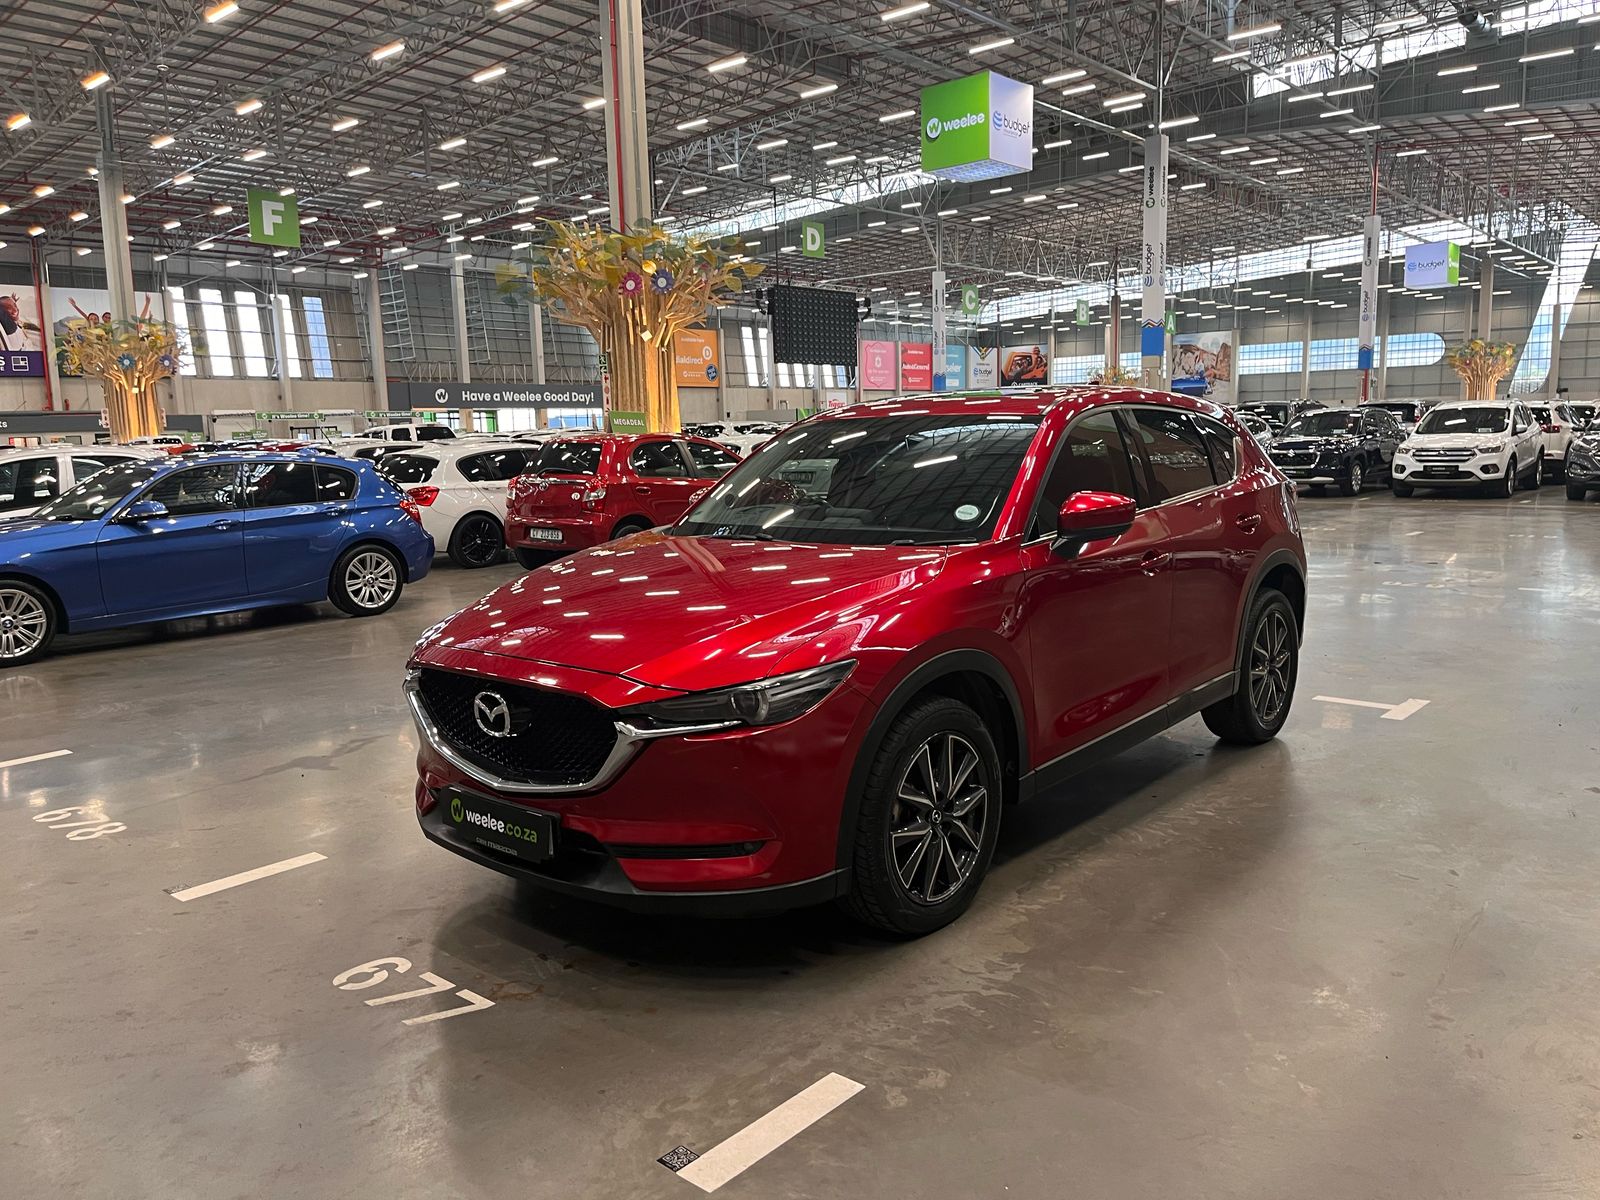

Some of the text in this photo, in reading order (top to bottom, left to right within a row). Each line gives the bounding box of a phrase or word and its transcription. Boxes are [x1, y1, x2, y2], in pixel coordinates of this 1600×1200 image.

[943, 112, 985, 132] weelee
[1003, 114, 1030, 137] budget
[261, 200, 285, 237] F
[806, 226, 821, 253] D
[1144, 243, 1155, 275] budget
[1417, 259, 1445, 269] budget
[965, 290, 976, 310] C
[1079, 304, 1087, 321] B
[1167, 314, 1174, 331] A
[462, 391, 490, 402] Have
[493, 393, 500, 402] a
[502, 391, 542, 403] Weelee
[543, 391, 570, 403] Good
[571, 391, 595, 405] Day!
[613, 418, 645, 426] MEGADEAL
[465, 809, 538, 844] weelee.co.za
[332, 956, 497, 1026] 677
